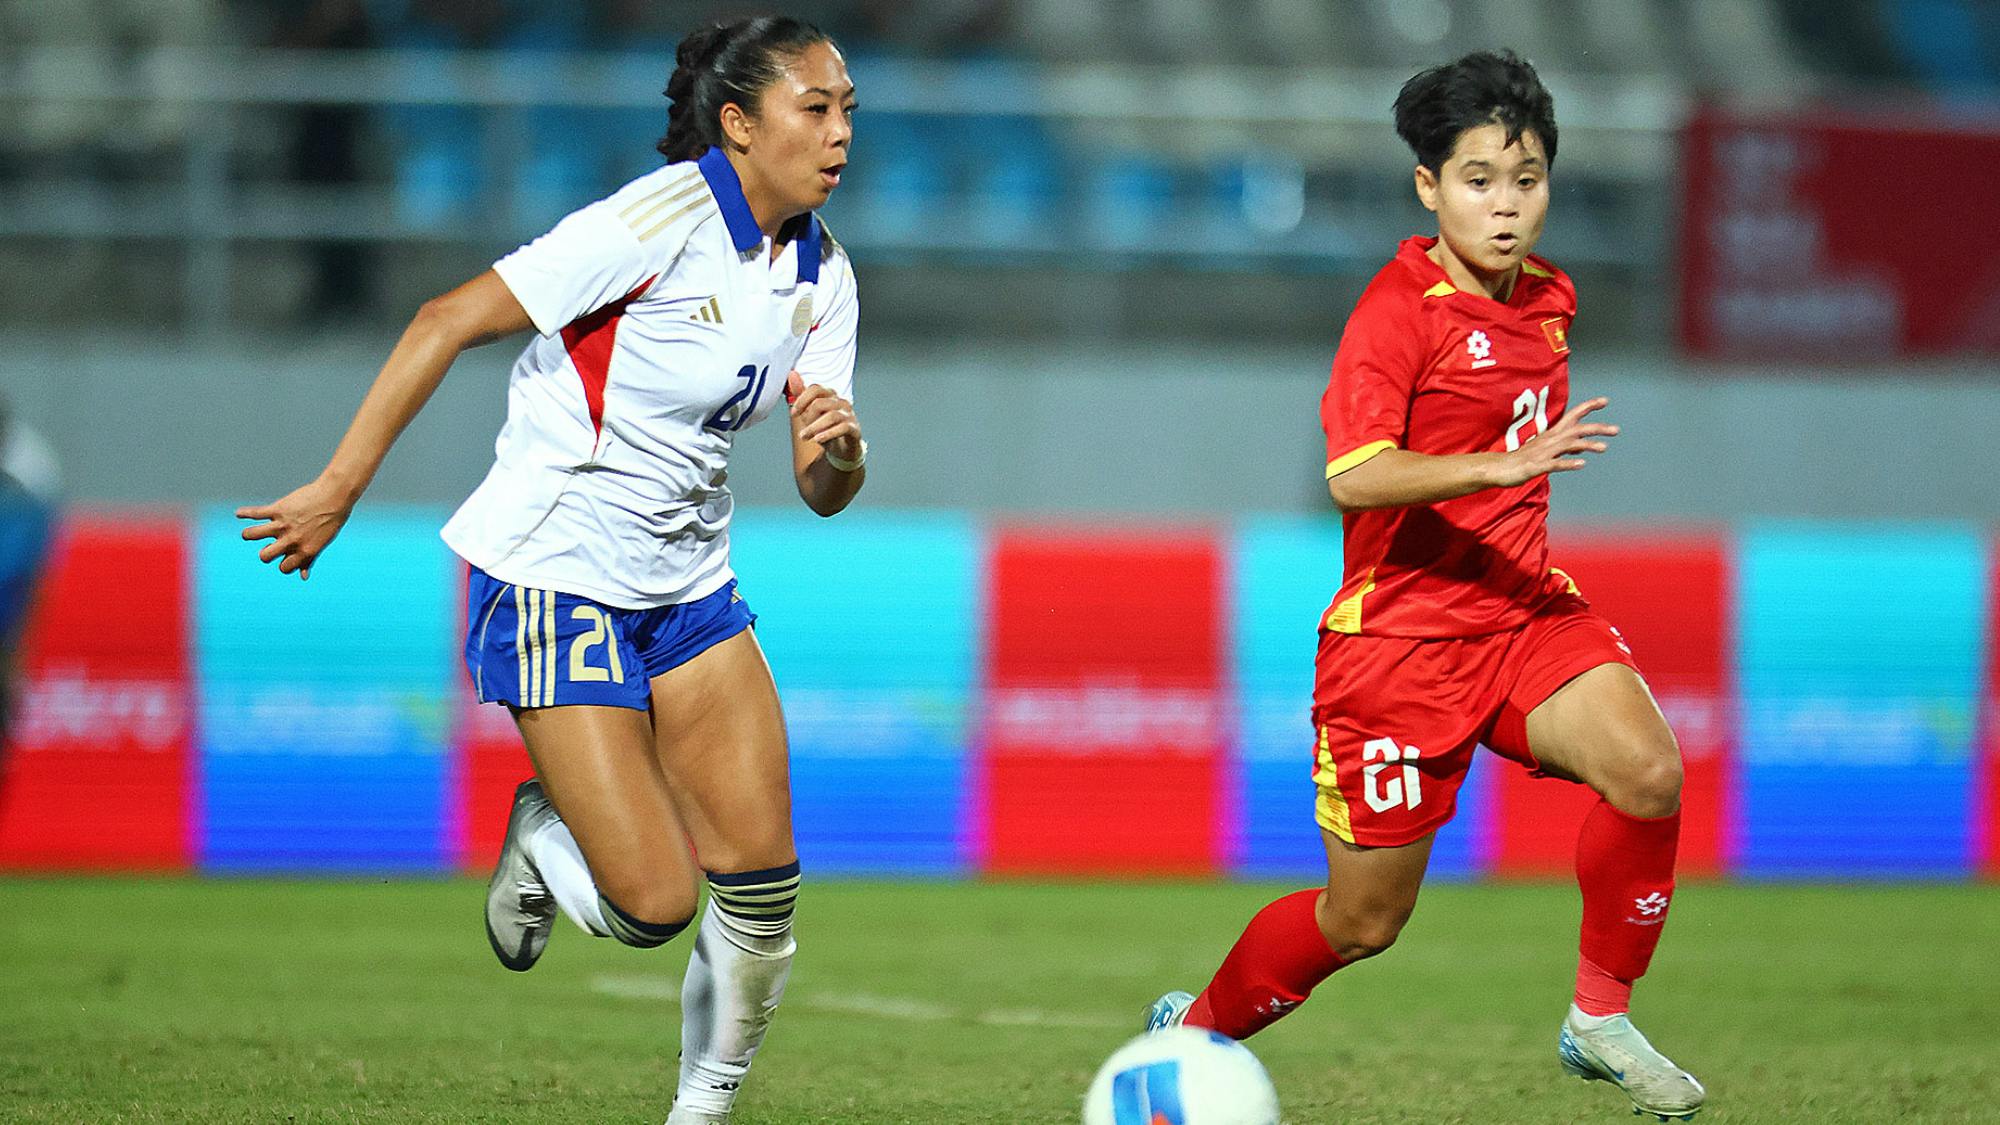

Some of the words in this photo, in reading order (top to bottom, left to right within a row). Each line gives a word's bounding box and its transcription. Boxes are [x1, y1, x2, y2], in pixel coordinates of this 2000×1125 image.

[702, 364, 769, 431] 21
[1505, 385, 1549, 452] 21
[569, 605, 624, 684] 21
[1362, 736, 1422, 813] 21
